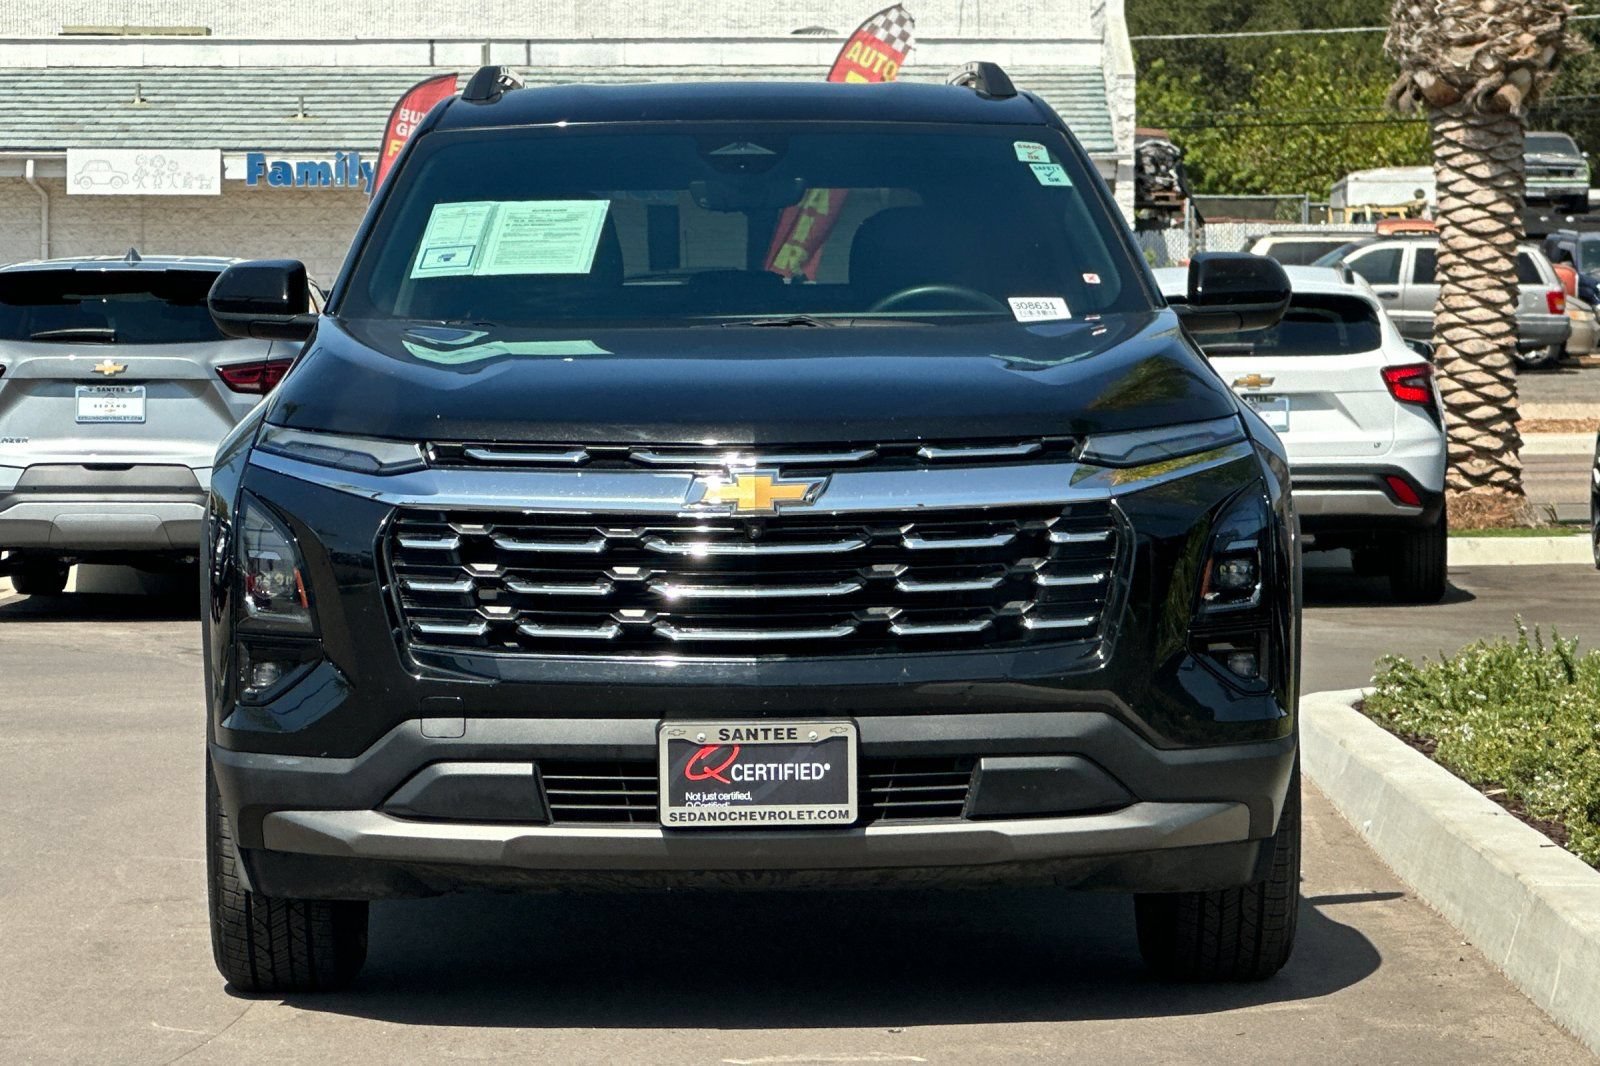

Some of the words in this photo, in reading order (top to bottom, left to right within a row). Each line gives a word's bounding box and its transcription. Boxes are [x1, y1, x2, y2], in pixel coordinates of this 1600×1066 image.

[845, 40, 897, 82] AUTO
[246, 151, 375, 195] Family
[1013, 301, 1057, 310] 308631
[718, 727, 798, 741] SANTEE
[685, 791, 701, 801] Not
[701, 791, 717, 803] just
[669, 809, 850, 823] SEDANOCHEVROLET.COM
